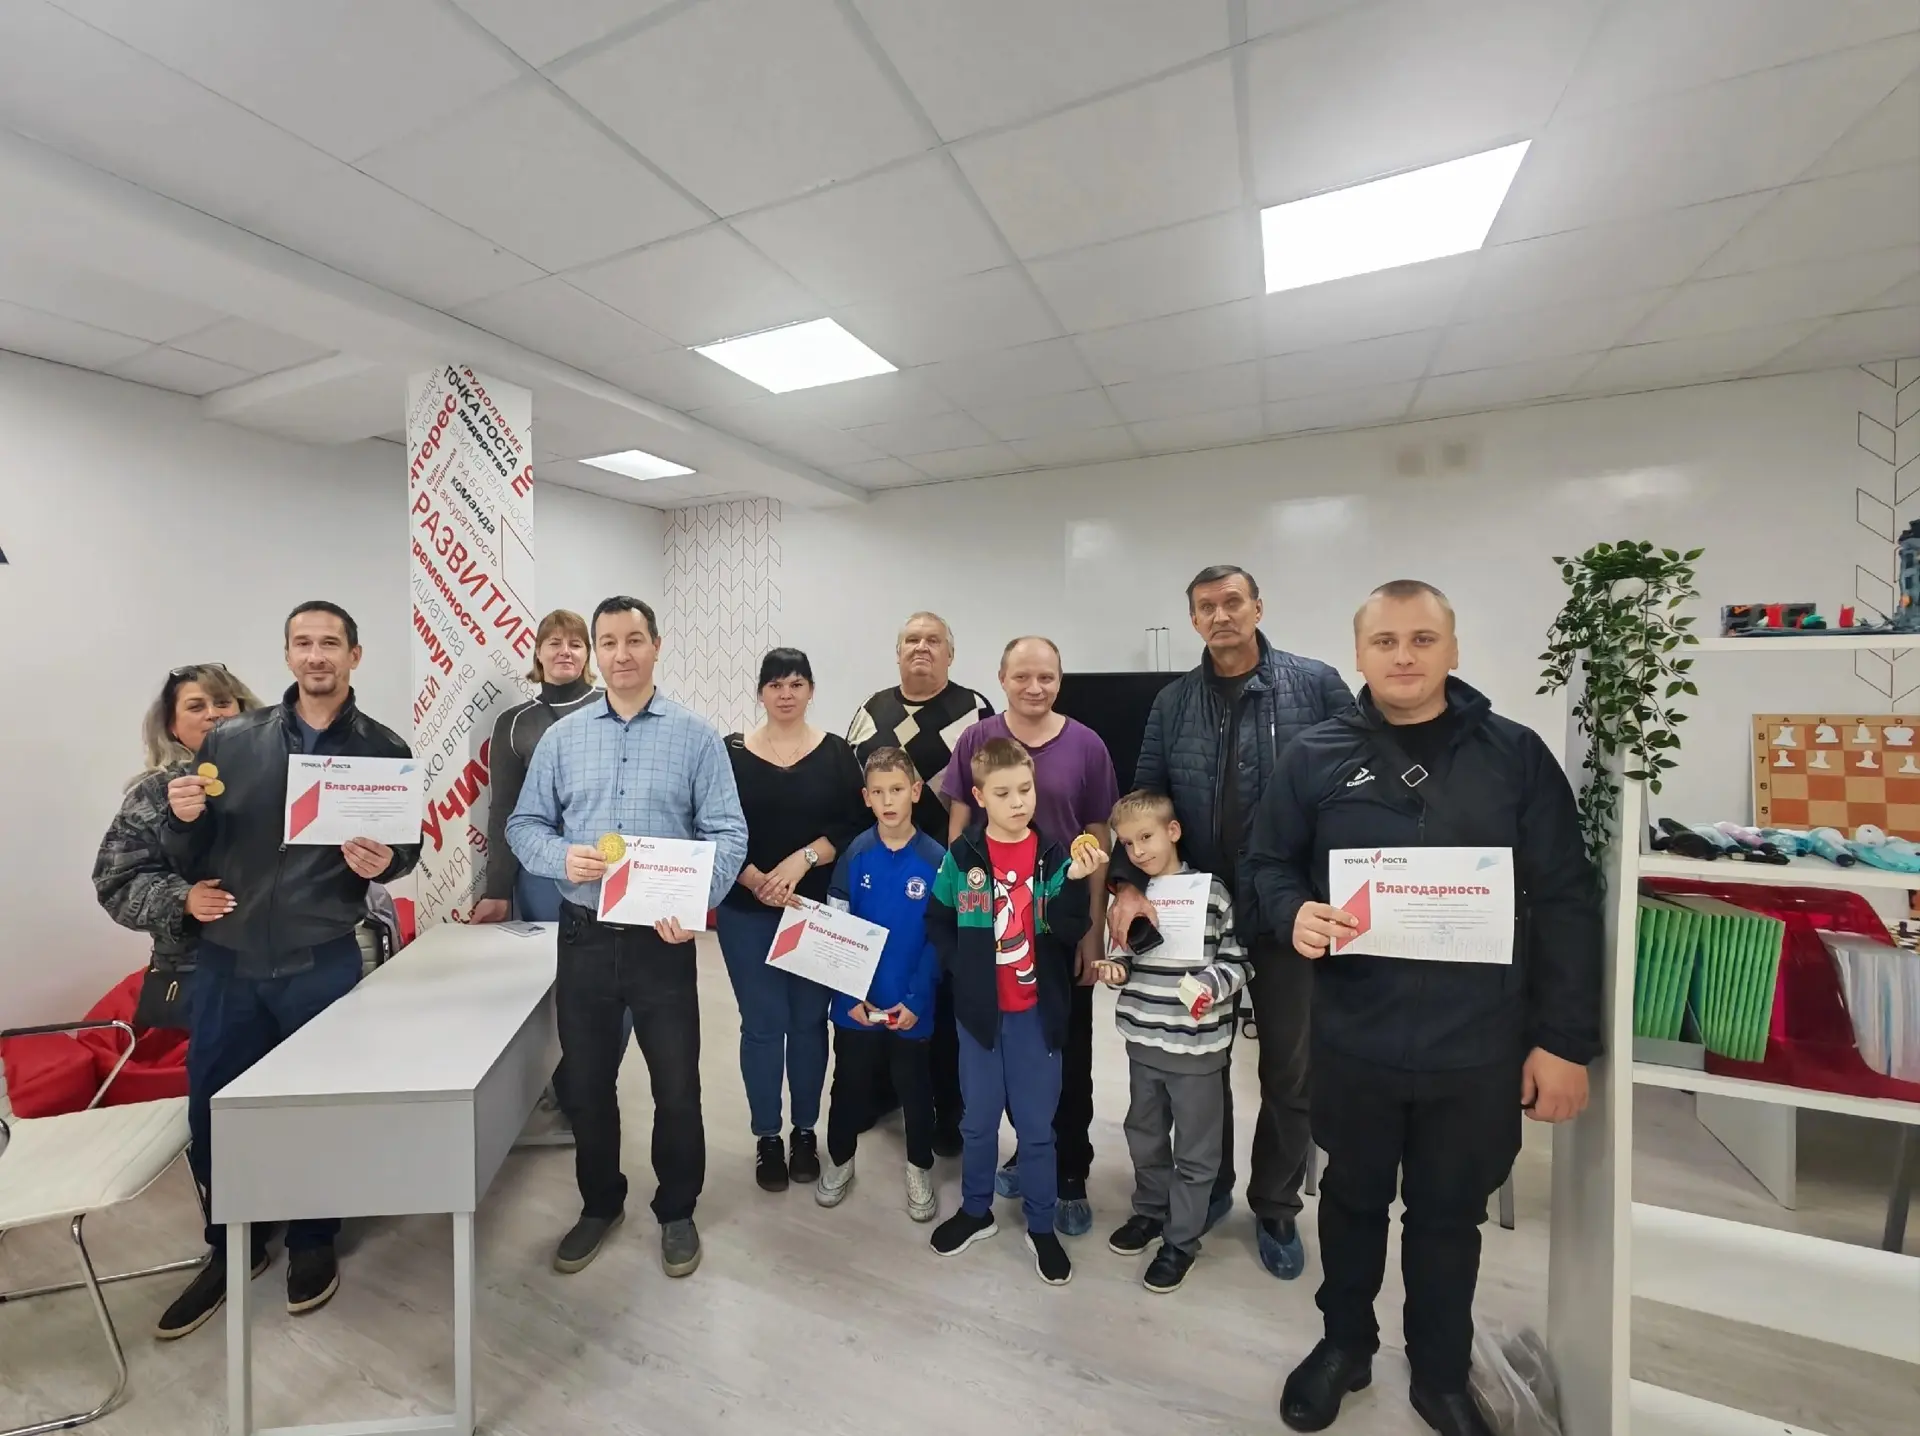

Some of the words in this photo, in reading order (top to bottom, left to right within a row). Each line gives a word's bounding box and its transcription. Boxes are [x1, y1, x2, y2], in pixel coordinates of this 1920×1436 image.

[444, 365, 481, 416] ТОЧКА
[479, 414, 518, 470] РОСТА
[458, 408, 508, 477] лидерство
[450, 476, 496, 535] команда
[457, 461, 495, 514] РАБОТА
[440, 489, 498, 567] аккуратность
[412, 491, 537, 659] РАЗВИТИЕ
[413, 535, 486, 646] ременность
[442, 680, 503, 757] ВПЕРЕД
[324, 782, 408, 792] Благодарность
[633, 861, 698, 874] Благодарность
[1376, 882, 1490, 898] Благодарность
[807, 922, 870, 952] Благодарность
